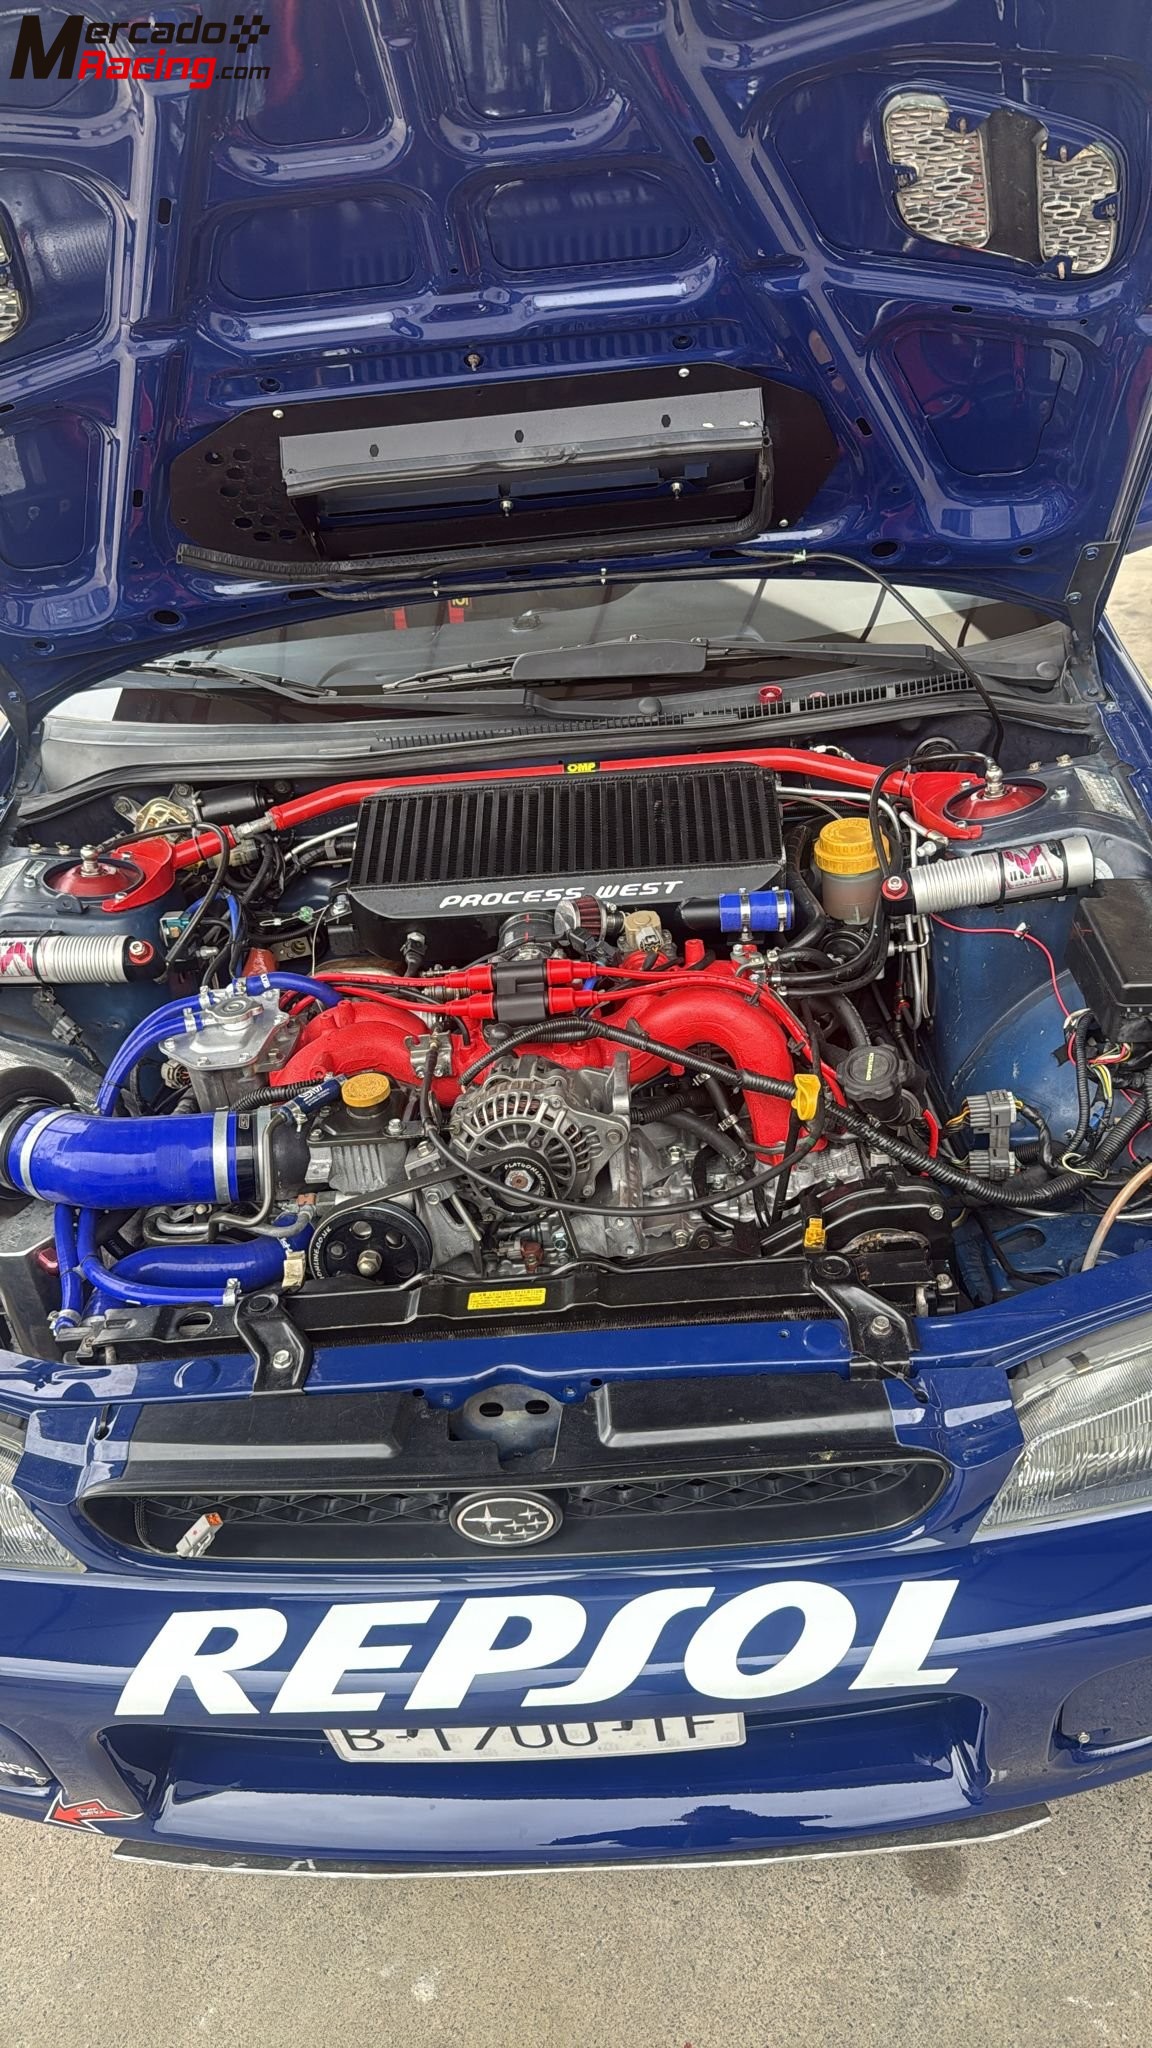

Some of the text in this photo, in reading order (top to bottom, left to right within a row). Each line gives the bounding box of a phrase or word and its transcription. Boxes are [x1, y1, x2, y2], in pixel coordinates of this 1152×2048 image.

[567, 761, 596, 773] OMP
[439, 880, 684, 909] PROCESS WEST
[114, 1579, 960, 1716] REPSOL
